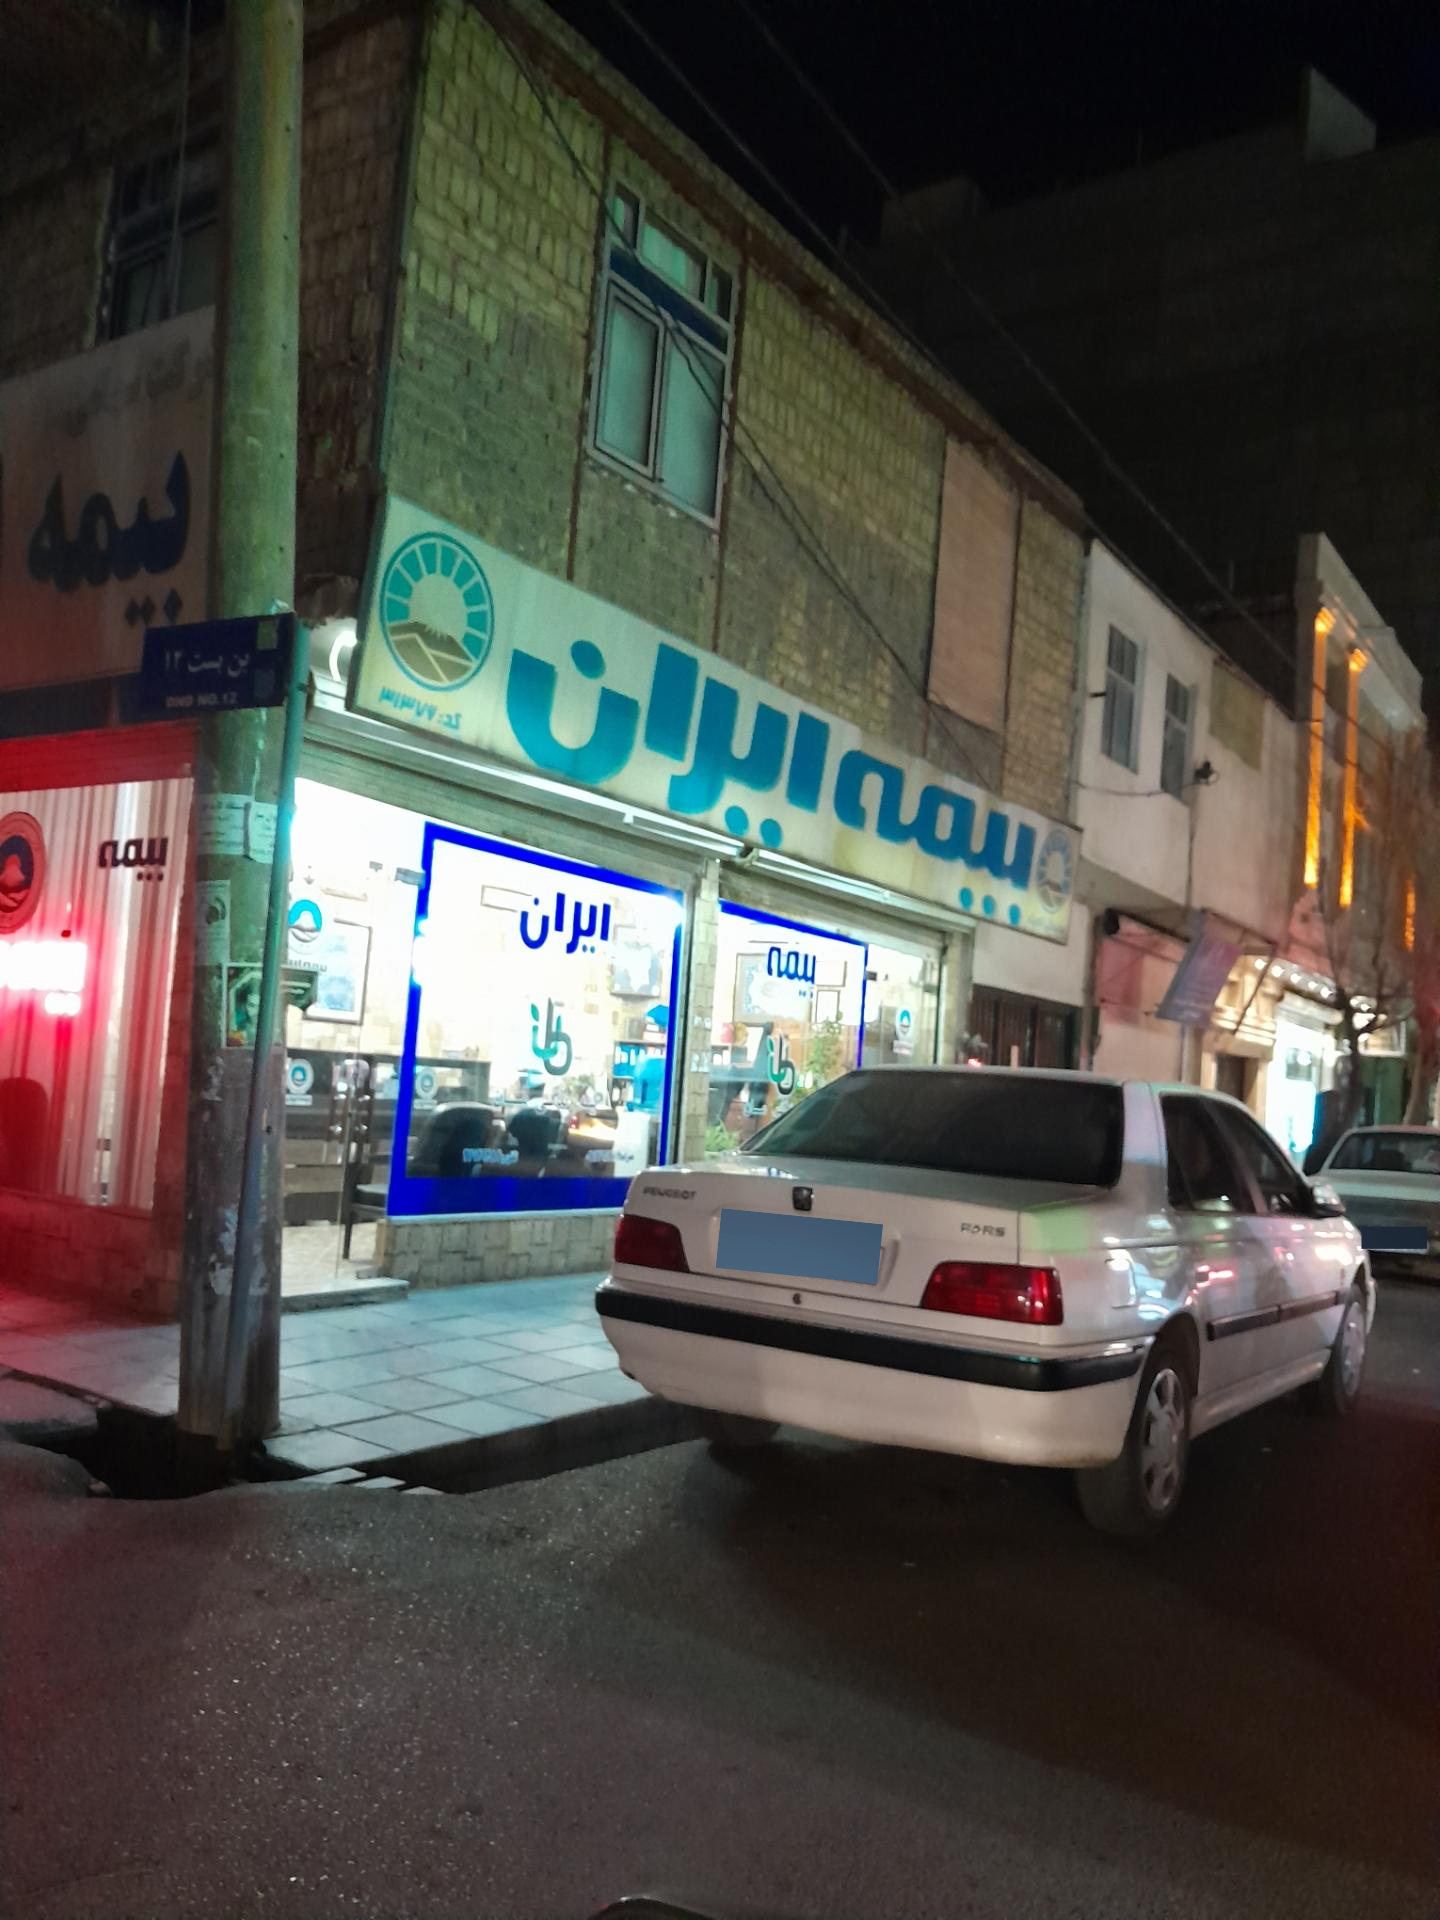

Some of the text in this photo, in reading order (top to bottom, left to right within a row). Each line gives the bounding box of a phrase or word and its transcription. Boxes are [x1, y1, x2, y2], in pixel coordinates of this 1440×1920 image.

[28, 449, 190, 627] بیمه
[188, 653, 223, 674] بست
[227, 652, 251, 678] بن
[506, 639, 1037, 926] بیمه ایران
[98, 836, 168, 882] بیمه
[519, 892, 611, 954] ایران
[767, 946, 816, 999] بیمه
